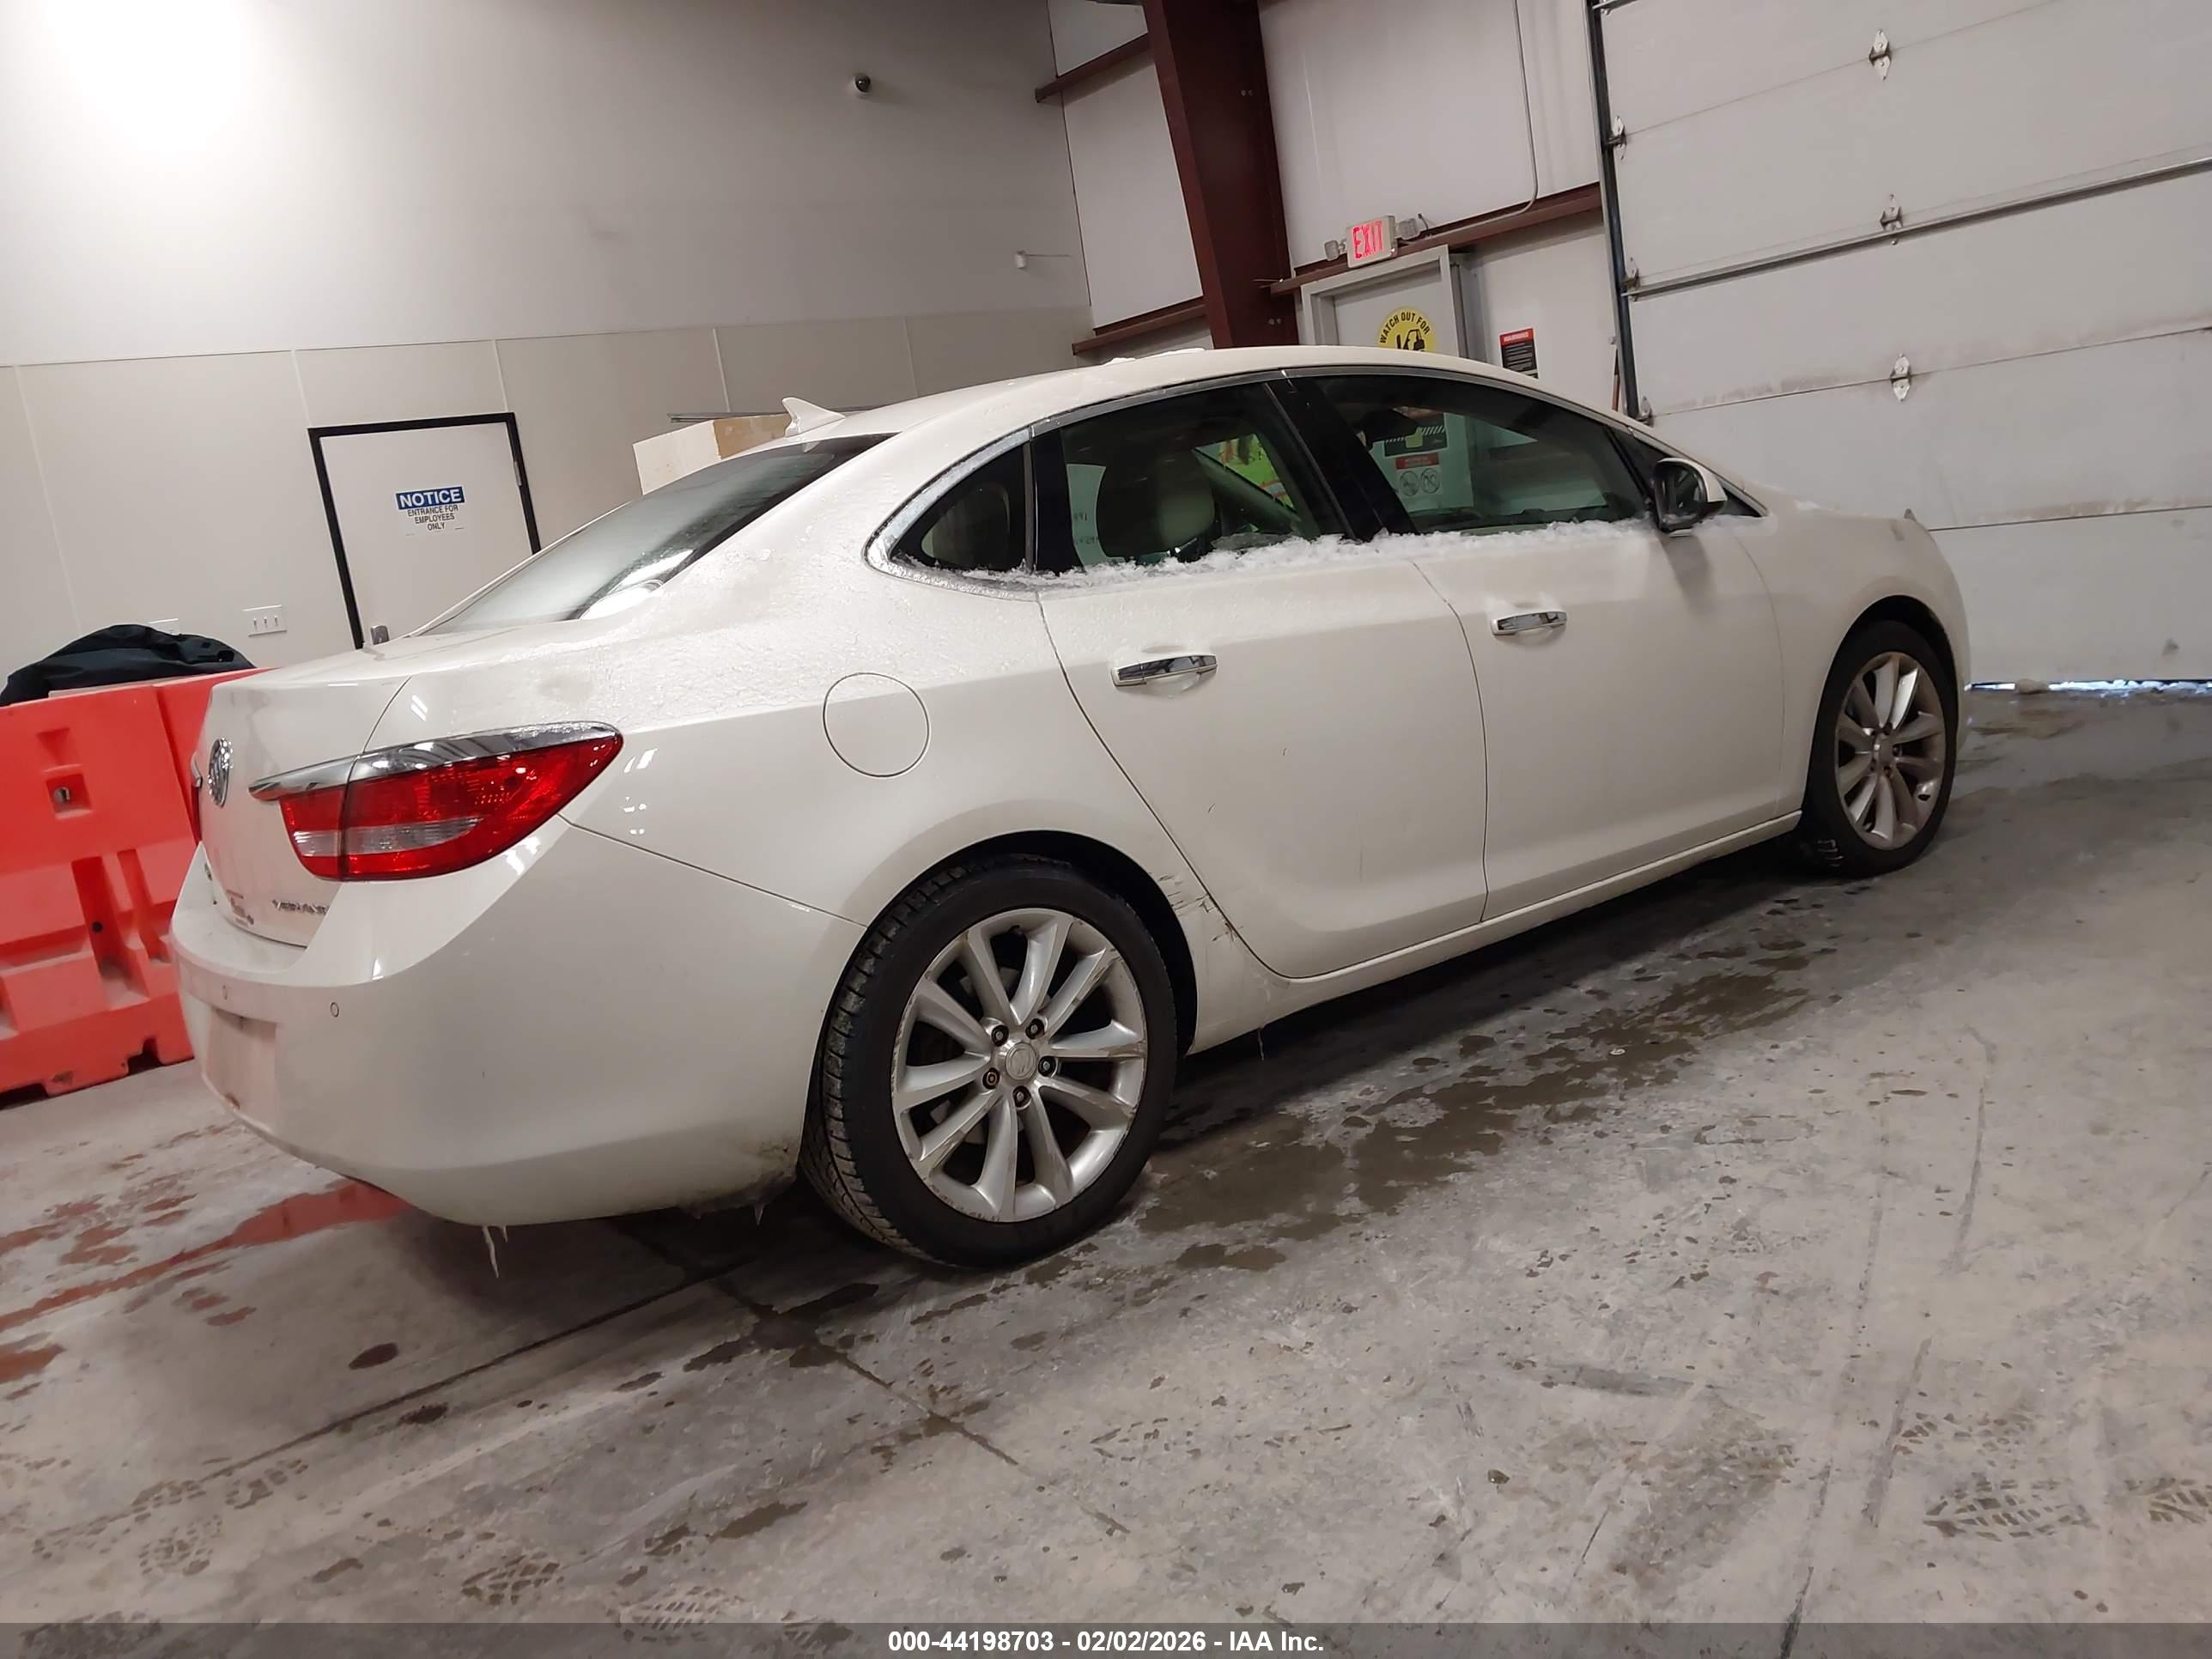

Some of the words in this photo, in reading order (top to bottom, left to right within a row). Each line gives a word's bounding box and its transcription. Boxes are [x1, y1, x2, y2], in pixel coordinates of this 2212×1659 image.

[1352, 220, 1383, 259] EXIT
[1379, 314, 1400, 343] WATCH
[1401, 311, 1416, 322] OUT
[1416, 316, 1431, 335] FOR
[399, 489, 462, 507] NOTICE
[407, 506, 444, 517] ENTRANCE
[445, 504, 459, 513] FOR
[414, 513, 455, 524] EMPLOYEES
[427, 522, 445, 531] ONLY
